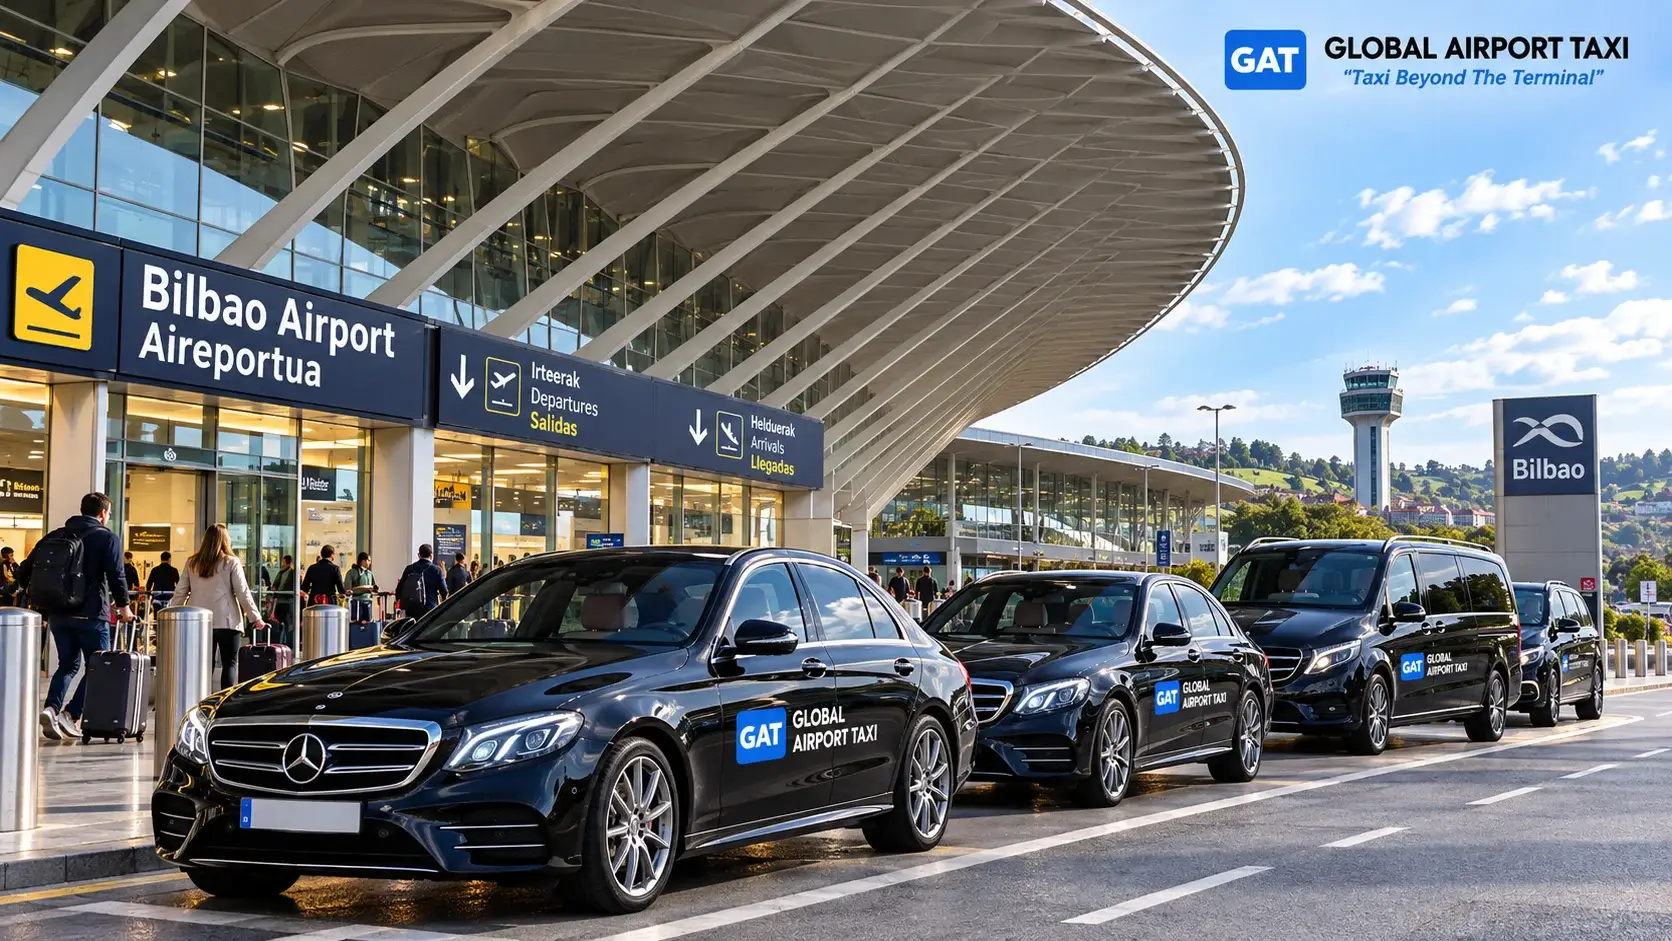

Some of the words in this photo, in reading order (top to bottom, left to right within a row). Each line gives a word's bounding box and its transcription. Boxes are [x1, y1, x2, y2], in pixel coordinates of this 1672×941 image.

[142, 263, 268, 332] Bilbao
[277, 297, 395, 359] Airport
[138, 321, 322, 388] Aireportua
[531, 361, 581, 390] Irteerak
[530, 386, 599, 418] Departures
[530, 411, 578, 438] Salidas
[750, 414, 796, 438] Helduerak
[750, 434, 785, 456] Arrivals
[750, 454, 795, 477] Llegadas
[1512, 457, 1586, 480] Bilbao
[1402, 660, 1423, 674] GAT
[1426, 652, 1453, 664] GLOBAL
[1454, 661, 1469, 673] TAXI
[1156, 689, 1178, 706] GAT
[1182, 679, 1211, 694] GLOBAL
[1182, 694, 1213, 709] AIRPORT
[1213, 692, 1227, 705] TAXI
[792, 705, 846, 729] GLOBAL
[739, 721, 783, 750] GAT
[792, 727, 849, 753] AIRPORT
[851, 723, 878, 746] TAXI
